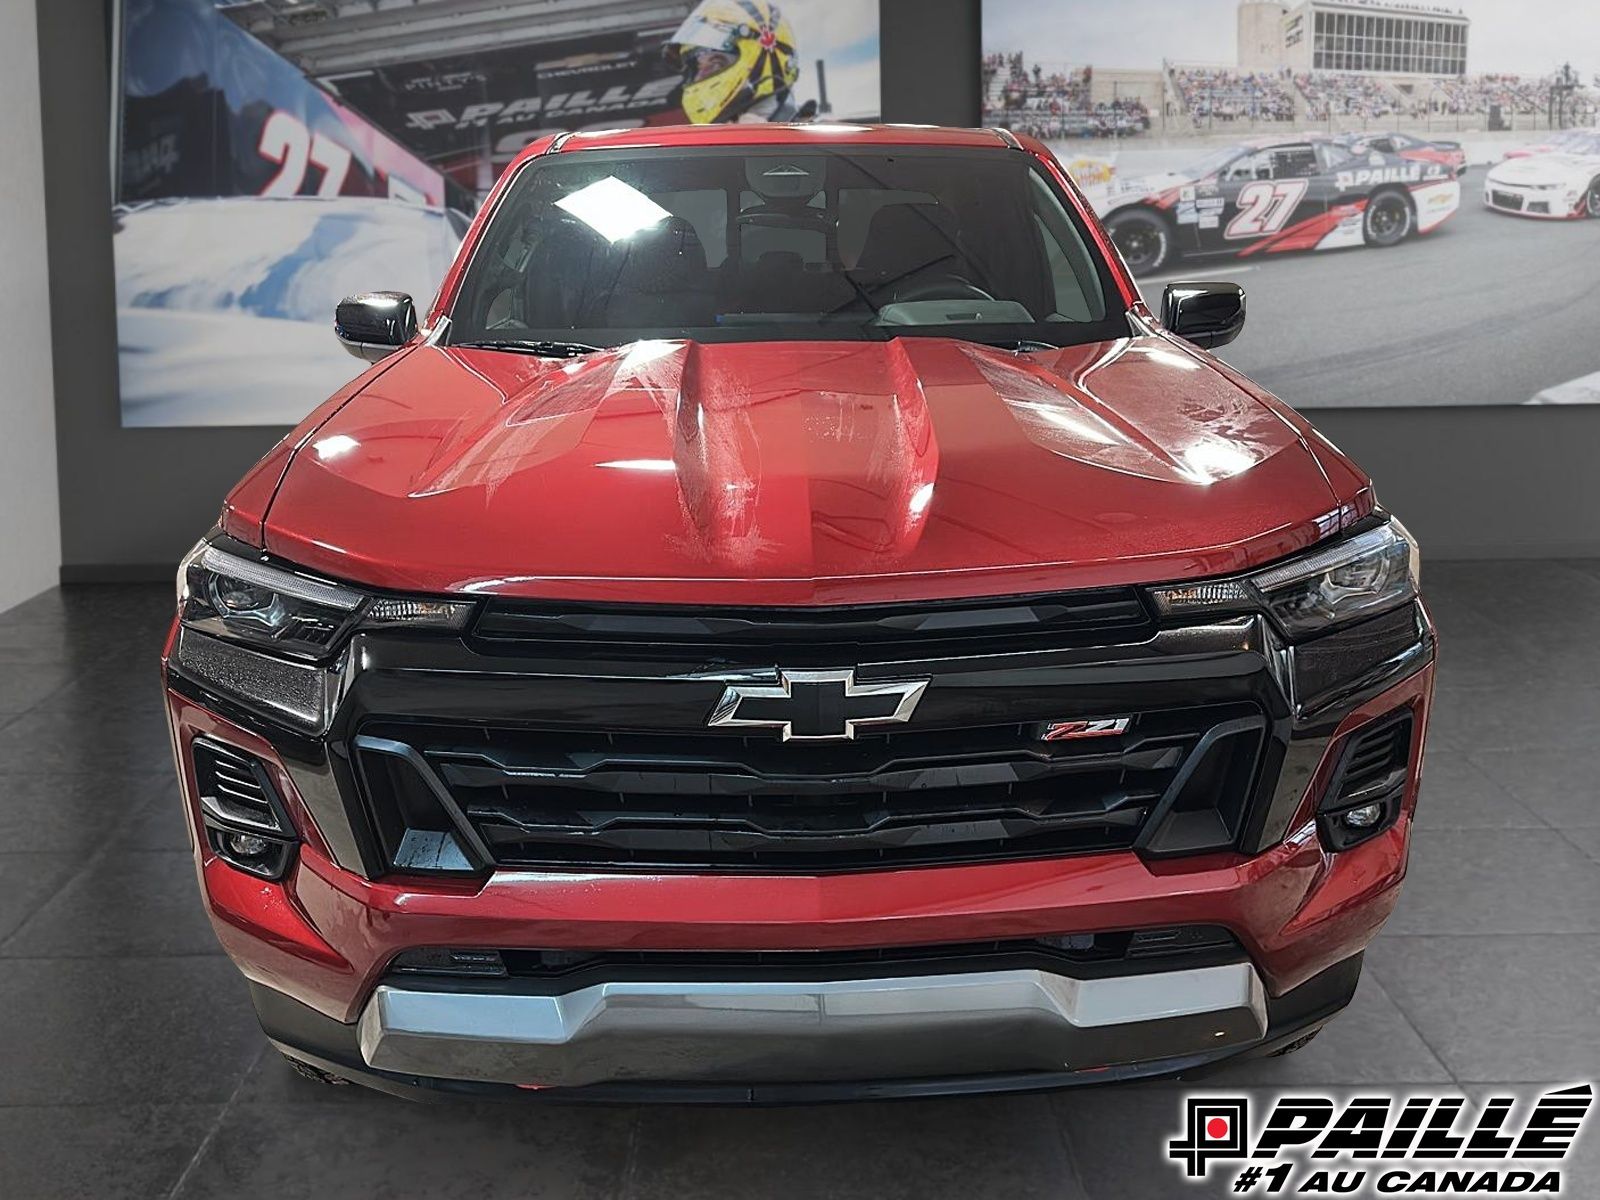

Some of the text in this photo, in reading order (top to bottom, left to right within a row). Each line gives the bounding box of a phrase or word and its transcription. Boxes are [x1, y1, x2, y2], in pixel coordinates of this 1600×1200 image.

[537, 61, 637, 80] CHEVROLET
[497, 113, 537, 125] AU
[545, 98, 668, 118] CANADA
[259, 110, 352, 198] 27
[1224, 179, 1307, 240] 27
[1041, 718, 1129, 740] Z71
